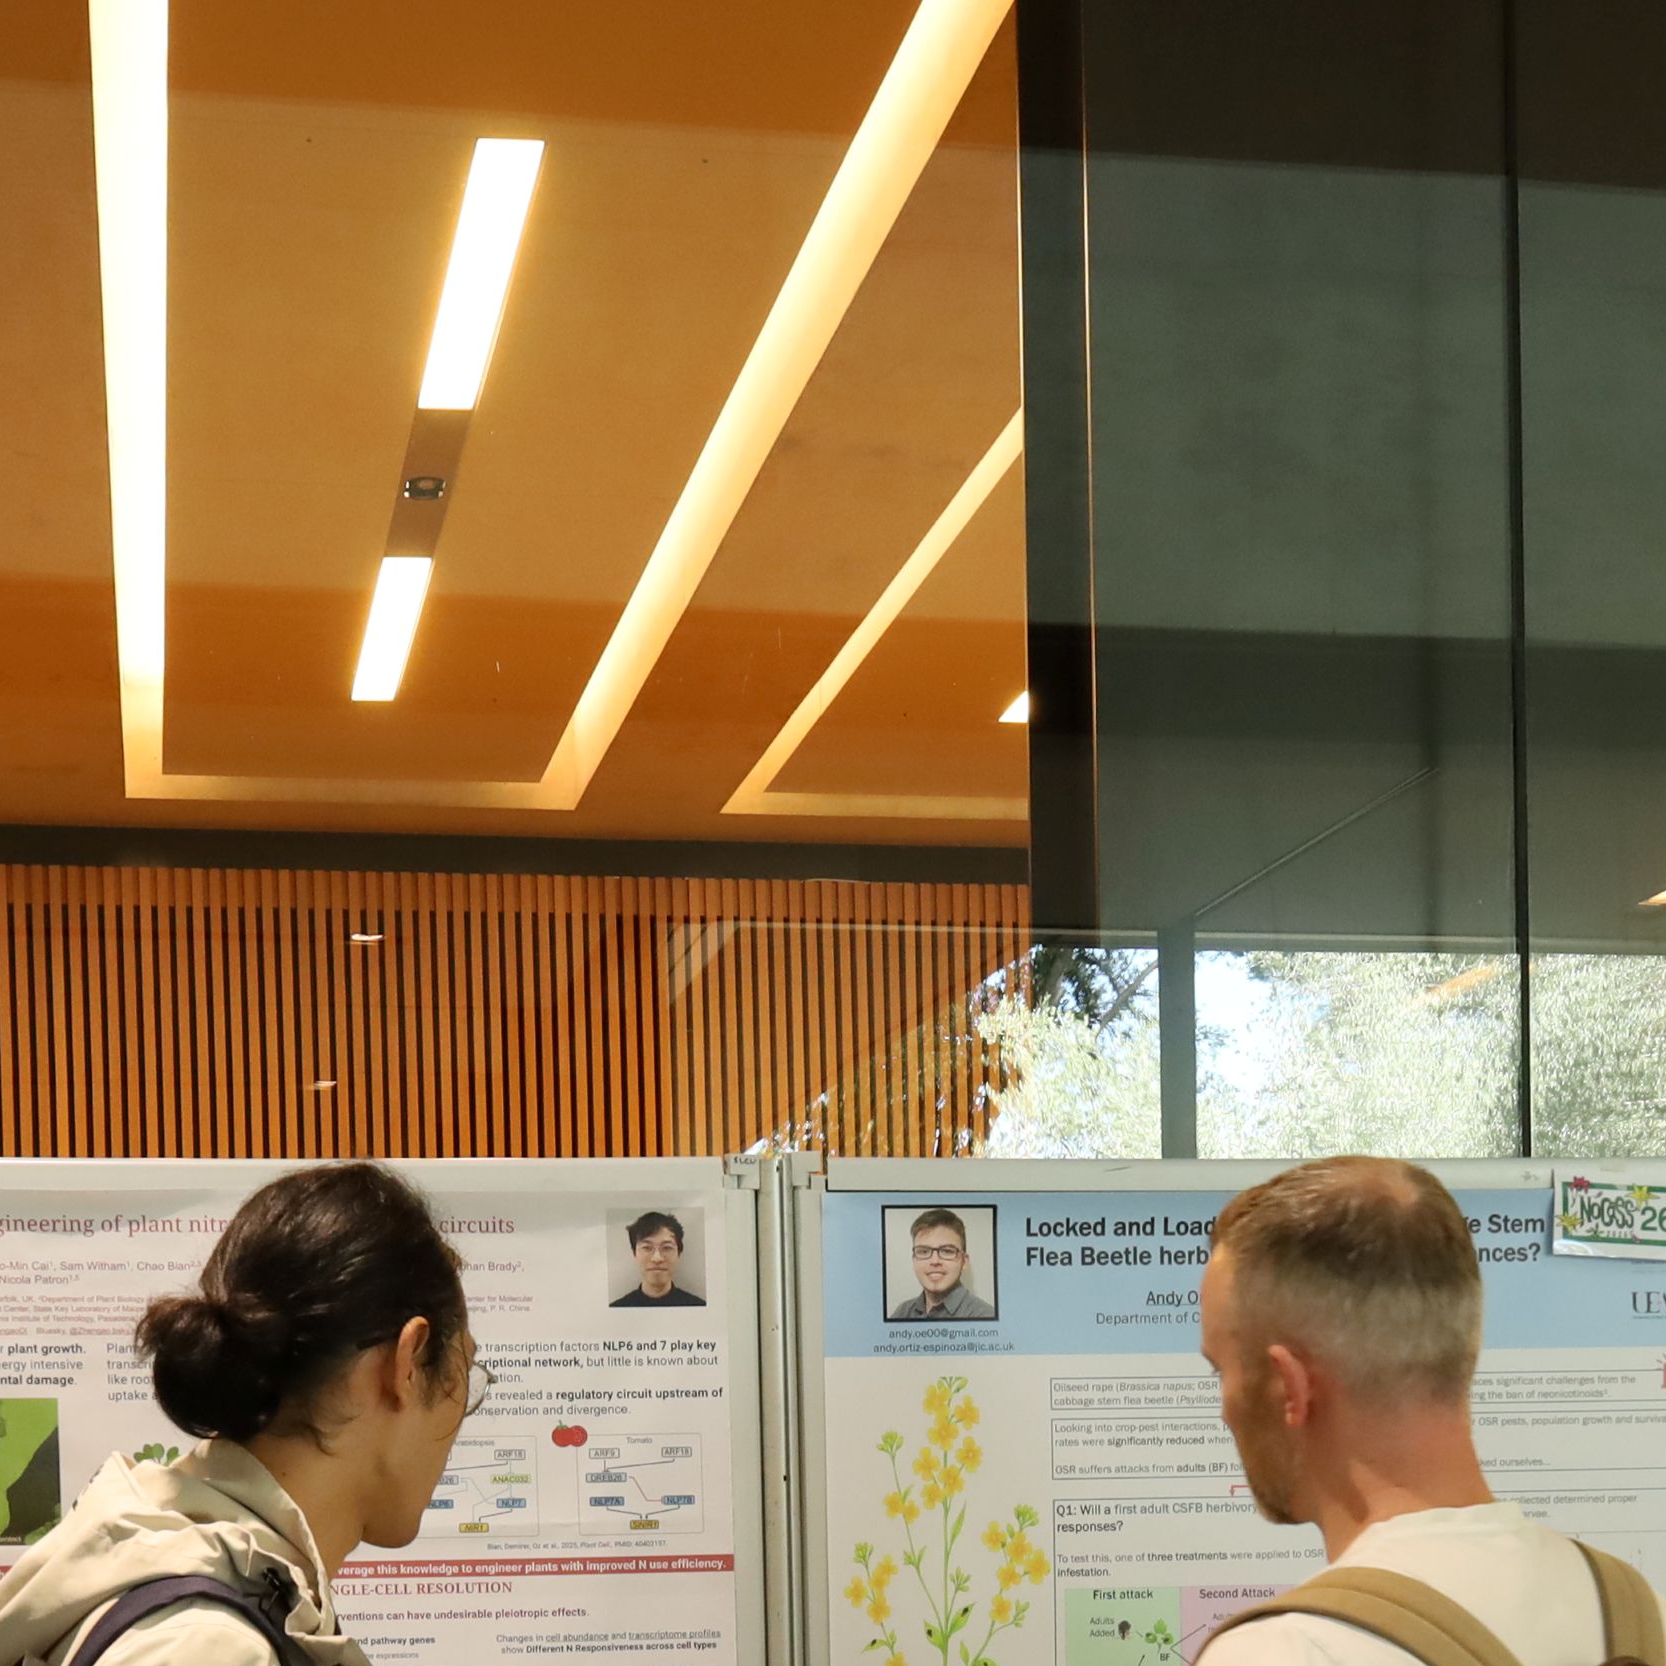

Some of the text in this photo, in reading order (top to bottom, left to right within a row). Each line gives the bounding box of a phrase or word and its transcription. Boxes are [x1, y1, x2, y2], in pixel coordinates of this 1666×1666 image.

[100, 1211, 123, 1233] of
[127, 1212, 182, 1239] plant
[440, 1214, 515, 1235] circuits
[1025, 1215, 1107, 1238] Locked
[1112, 1215, 1156, 1238] and
[1486, 1213, 1545, 1235] Stem
[1025, 1245, 1073, 1268] Flea
[1080, 1244, 1153, 1267] Beetle
[6, 1342, 39, 1358] plant
[40, 1342, 86, 1358] growth.
[25, 1373, 75, 1389] damage.
[337, 1558, 727, 1577] verage this knowledge to engineer plants with improved N use efficiency.
[1092, 1588, 1154, 1602] First attack
[1198, 1587, 1276, 1601] Second Attack
